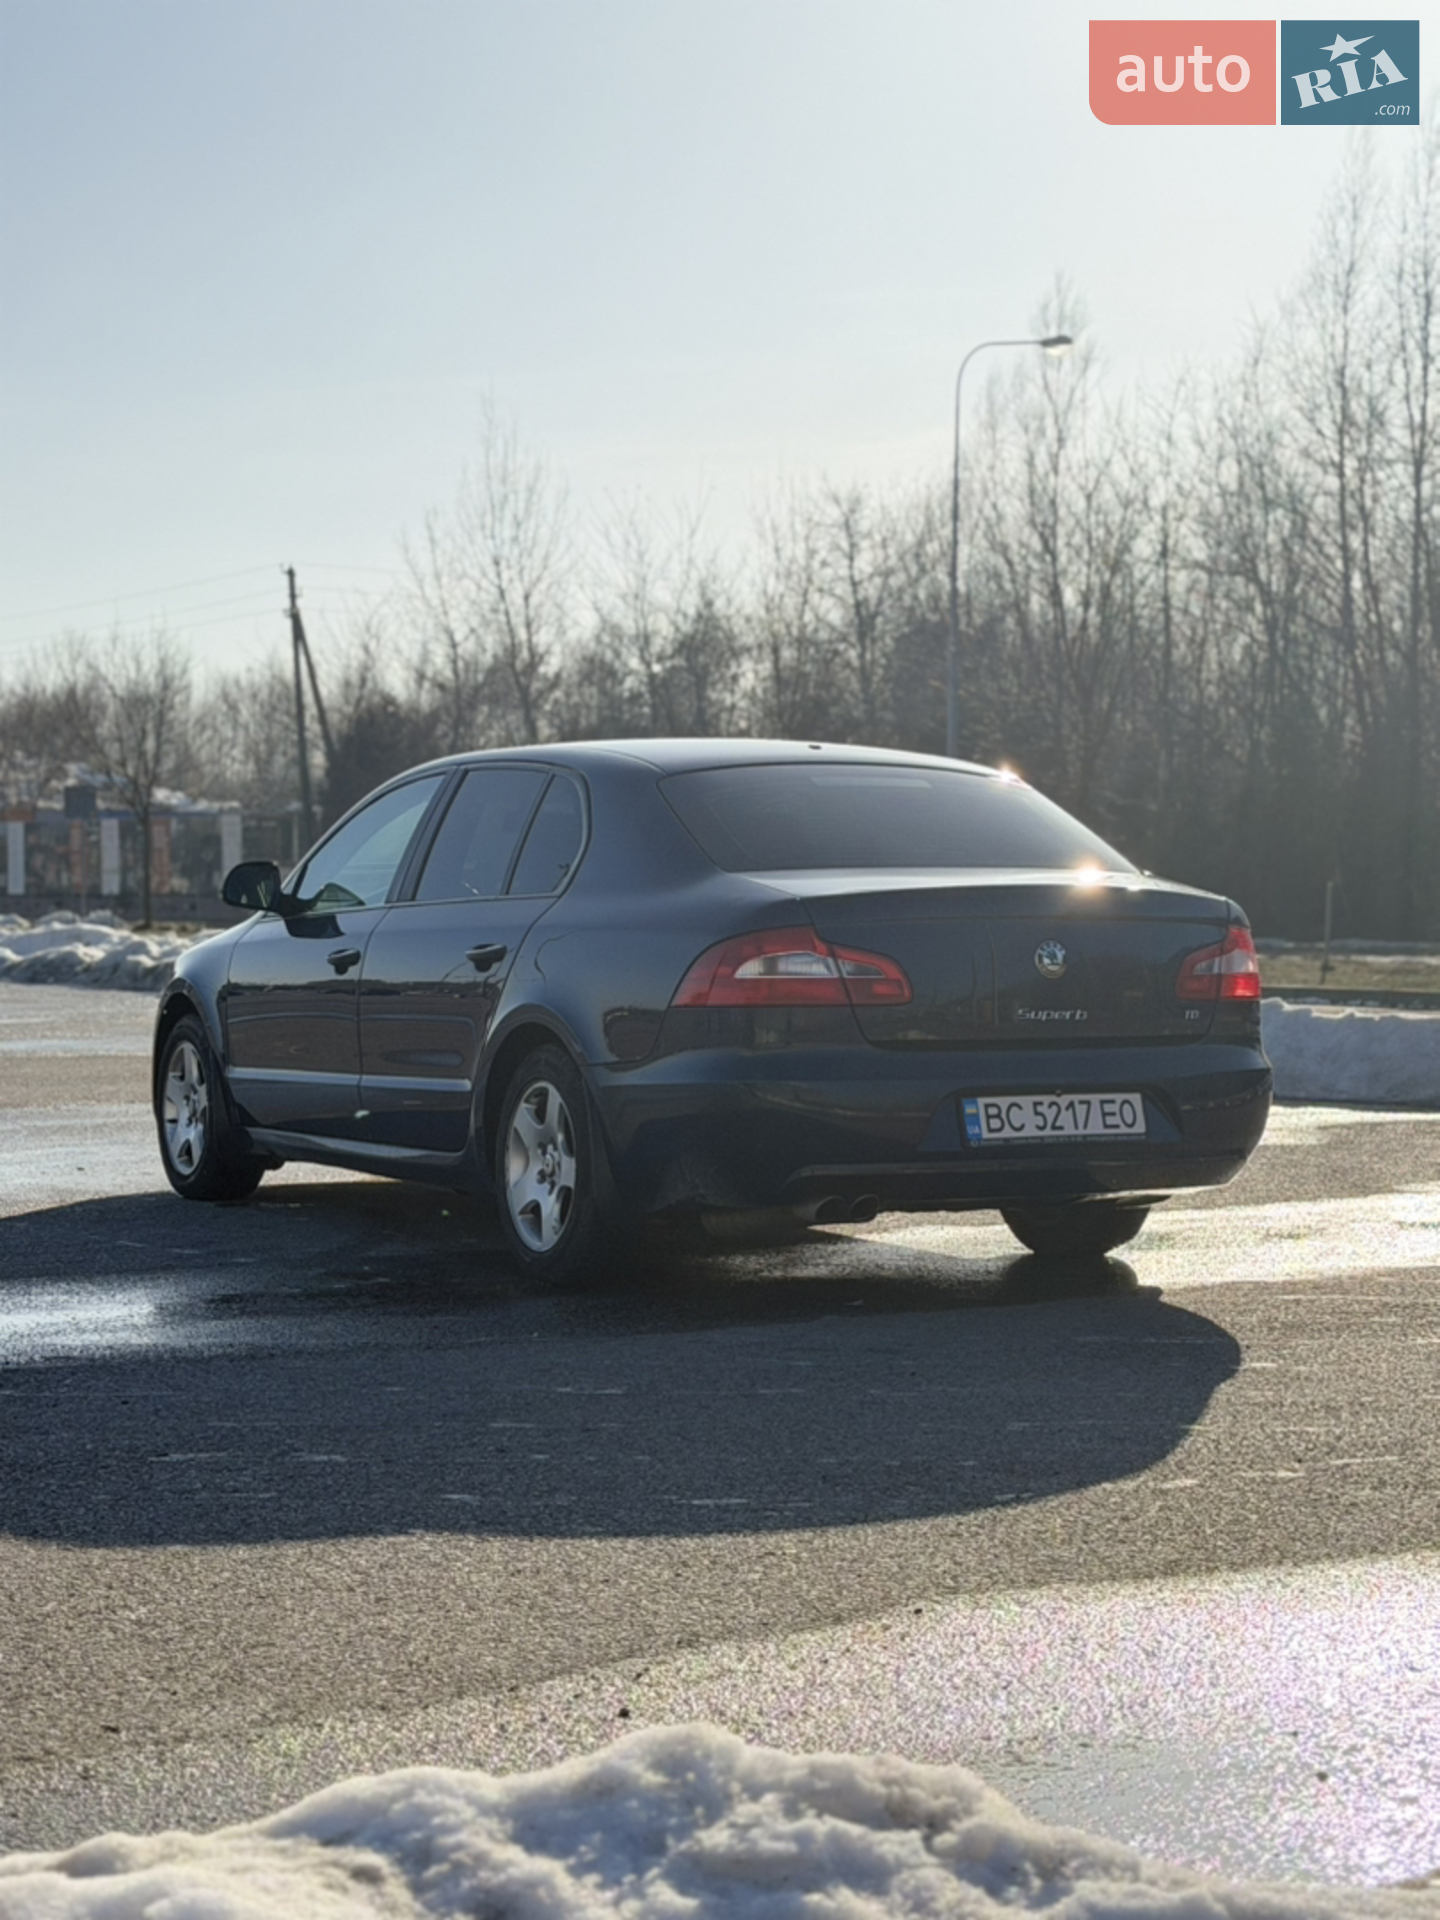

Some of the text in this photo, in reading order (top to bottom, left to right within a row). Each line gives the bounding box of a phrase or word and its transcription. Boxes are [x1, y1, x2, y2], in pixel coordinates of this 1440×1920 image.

[1017, 1008, 1088, 1021] Superb
[983, 1099, 1138, 1134] BC 5217 EO
[966, 1124, 981, 1135] UA
